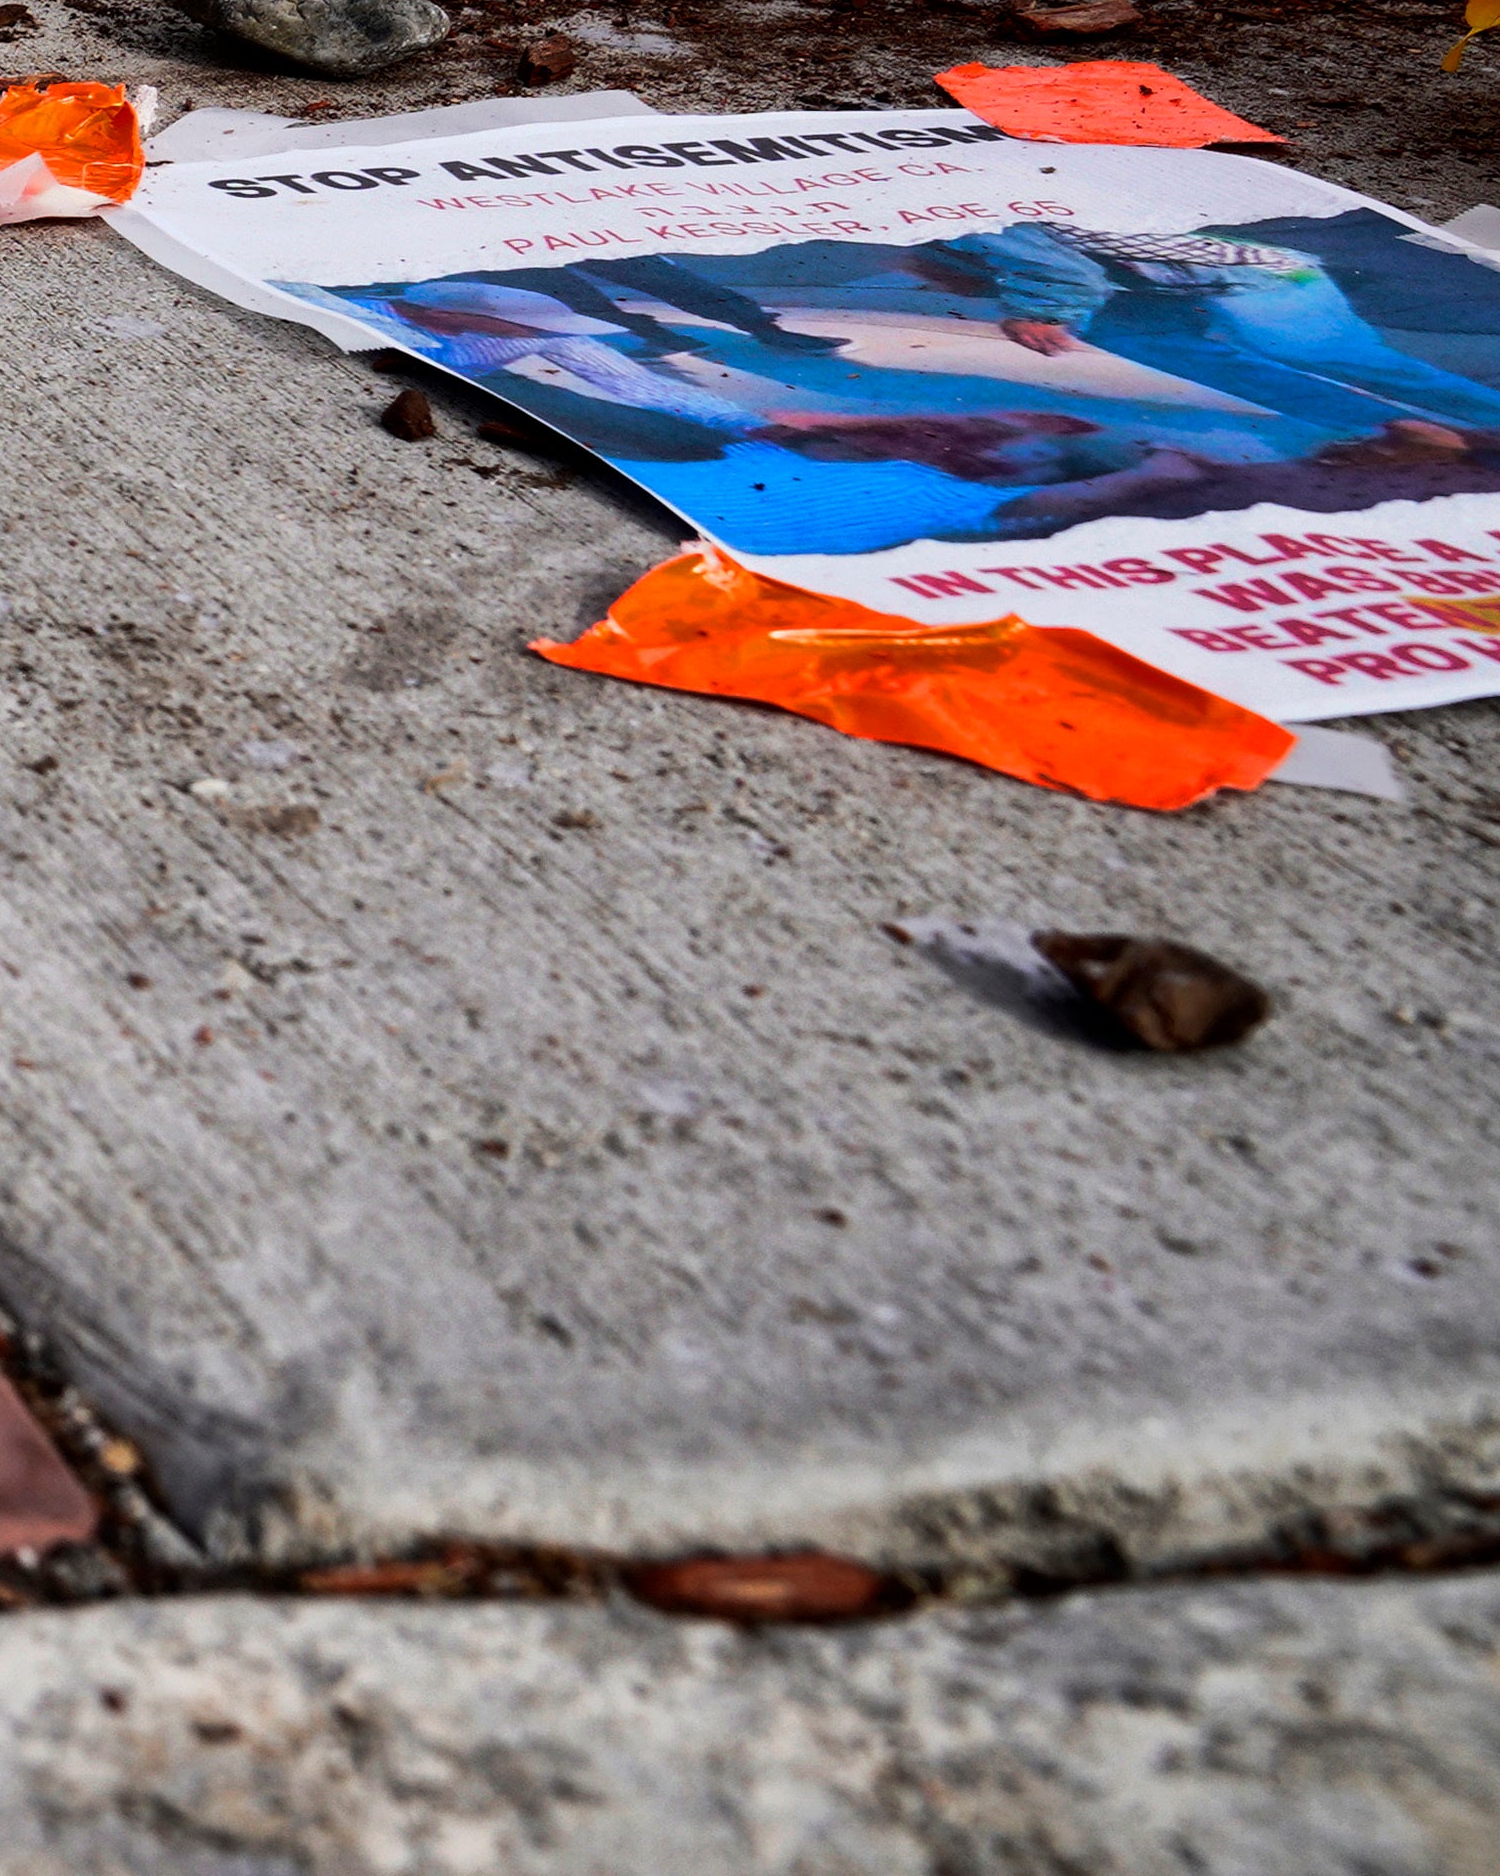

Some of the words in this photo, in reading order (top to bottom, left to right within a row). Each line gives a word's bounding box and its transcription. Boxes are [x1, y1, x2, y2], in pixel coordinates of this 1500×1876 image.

[208, 166, 421, 200] STOP
[439, 124, 1020, 182] ANTISEMITISM
[415, 182, 684, 212] WESTLAKE
[685, 165, 894, 198] VILLAGE
[897, 161, 986, 179] CA.
[501, 227, 643, 256] PAUL
[645, 218, 890, 242] KESSLER,
[896, 201, 1003, 226] AGE
[1007, 198, 1076, 219] 65
[884, 570, 997, 599] IN
[980, 556, 1179, 591] THIS
[1158, 532, 1429, 576] PLACE
[1411, 537, 1496, 564] A
[1192, 565, 1403, 614] WAS
[1276, 643, 1472, 687] PRO
